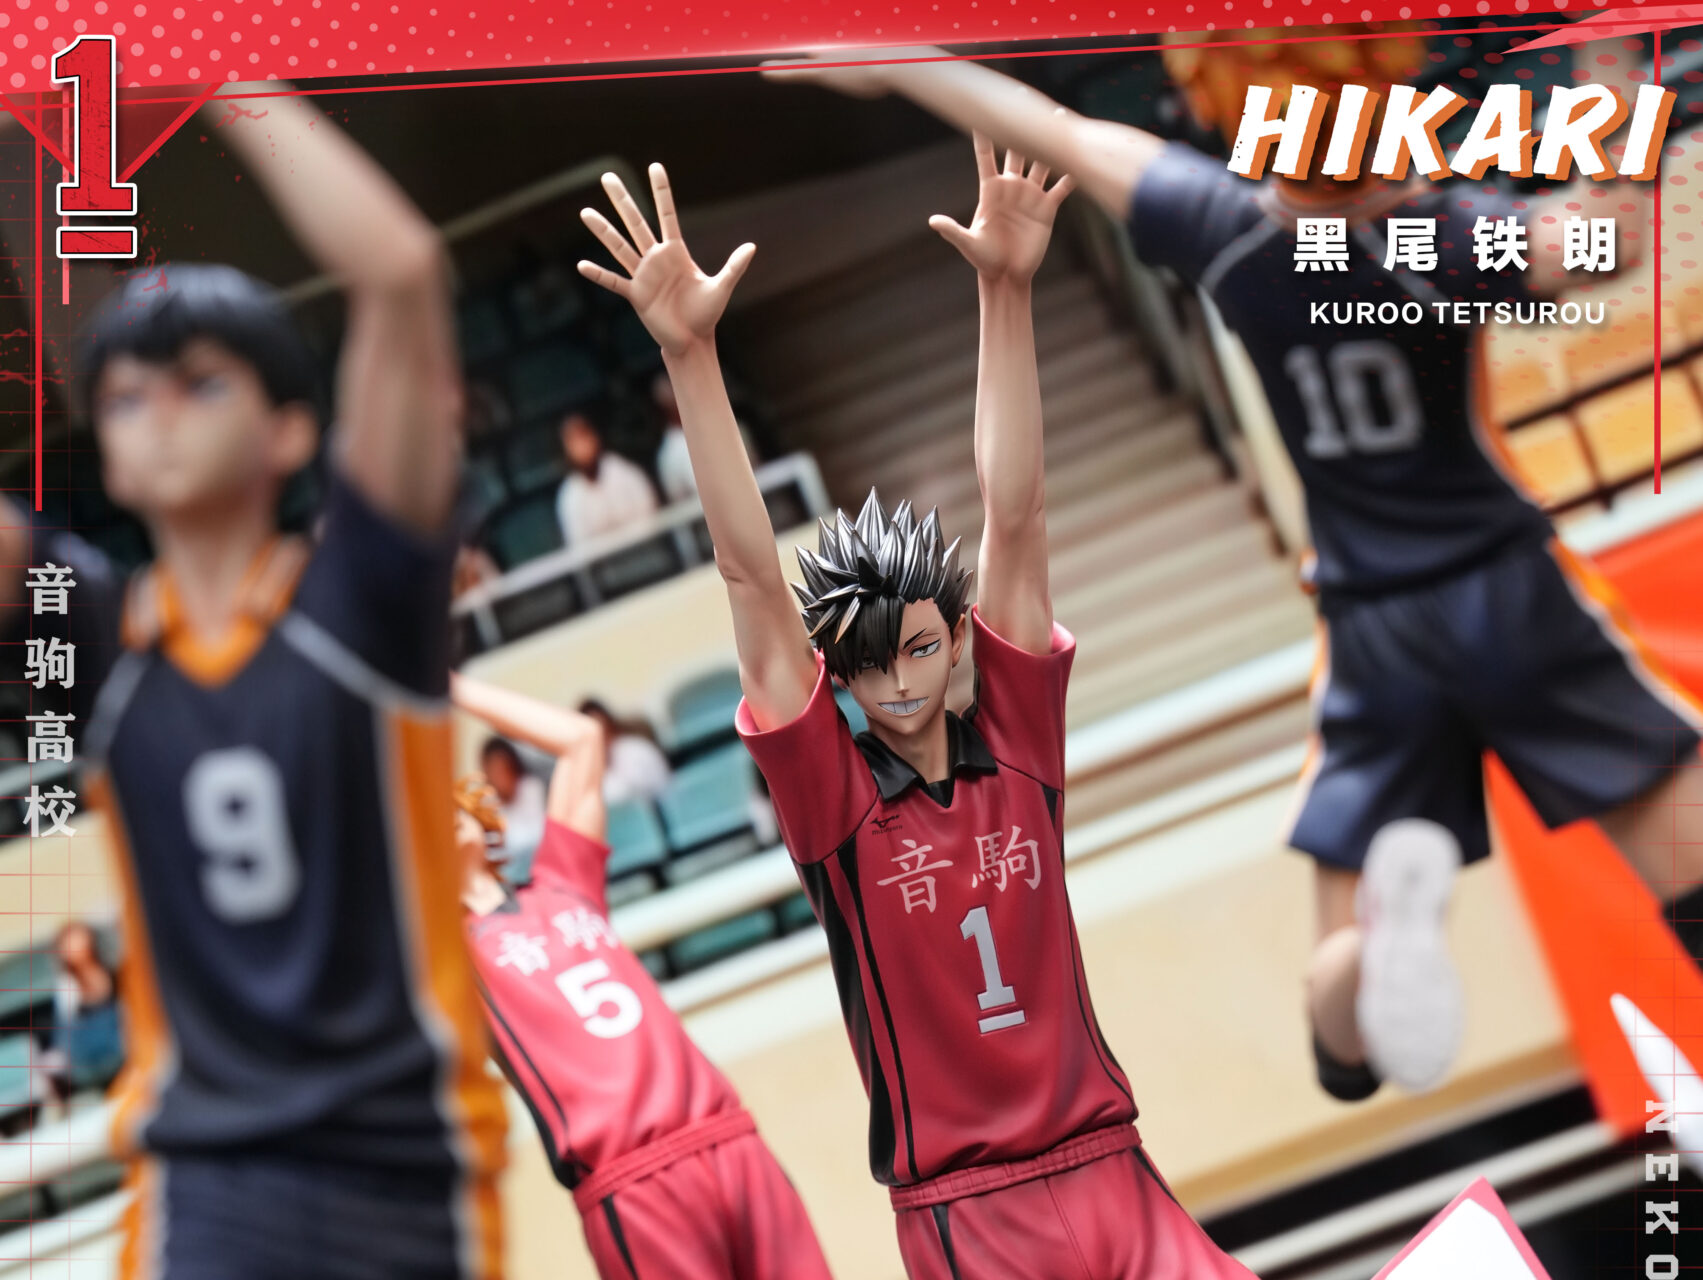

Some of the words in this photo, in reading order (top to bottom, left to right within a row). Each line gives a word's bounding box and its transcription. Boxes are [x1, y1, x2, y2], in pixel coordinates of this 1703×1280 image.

[1285, 339, 1424, 458] 10
[183, 747, 300, 922] 9
[877, 825, 1042, 914] 音駒
[555, 958, 643, 1038] 5
[959, 906, 1018, 1011] 1
